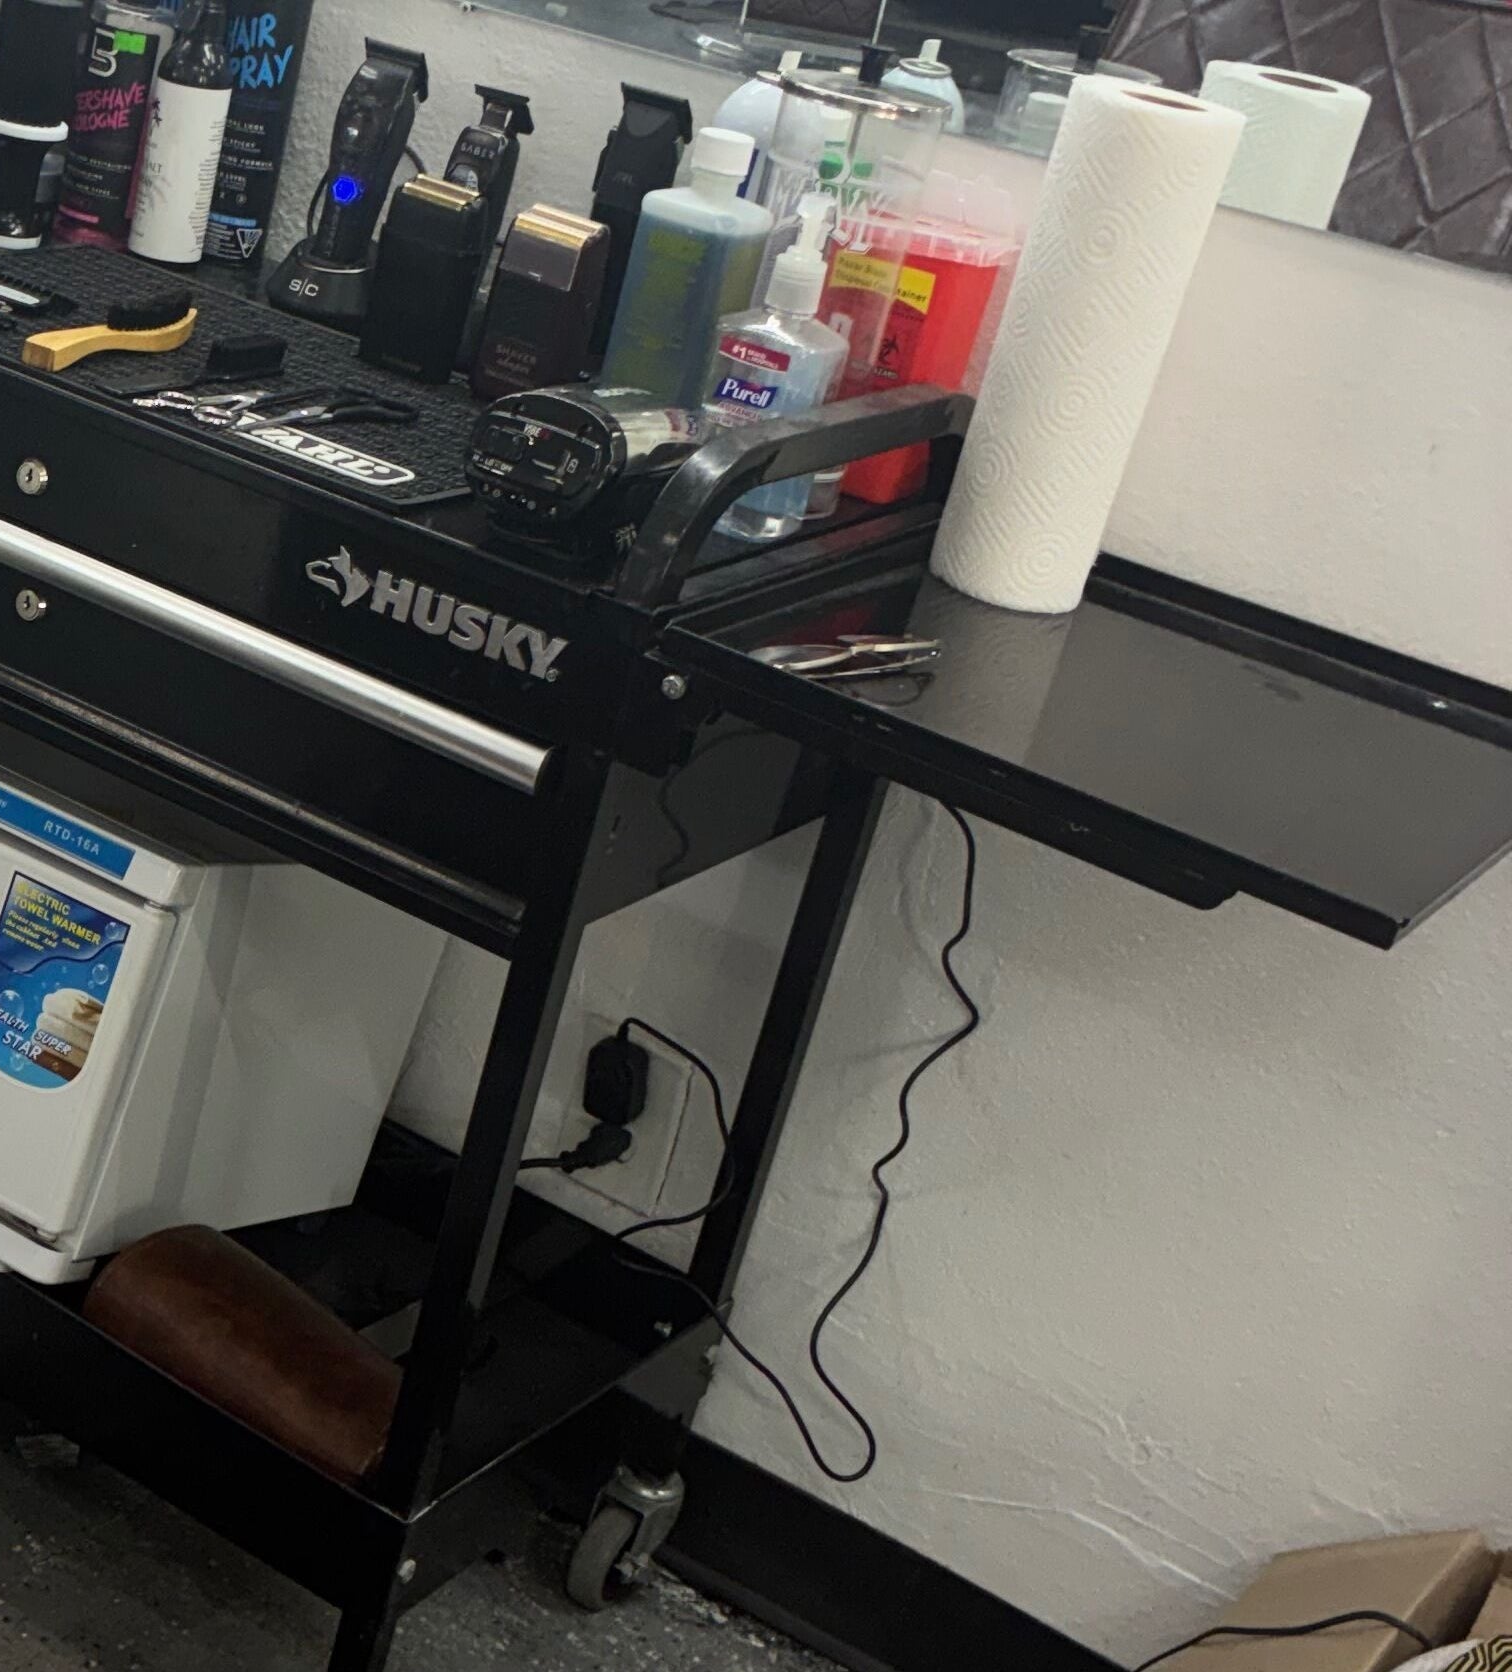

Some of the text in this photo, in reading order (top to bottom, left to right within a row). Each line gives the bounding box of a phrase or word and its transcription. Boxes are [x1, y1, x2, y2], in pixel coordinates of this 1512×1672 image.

[230, 44, 294, 89] PRAY
[75, 82, 146, 112] ERSHAVE
[732, 344, 747, 359] #1
[721, 378, 772, 408] Purell
[370, 569, 569, 680] HUSKY
[15, 881, 71, 916] ELECTRIC
[14, 896, 102, 945] TOWEL WARMER
[2, 1030, 72, 1061] STAR SUPER
